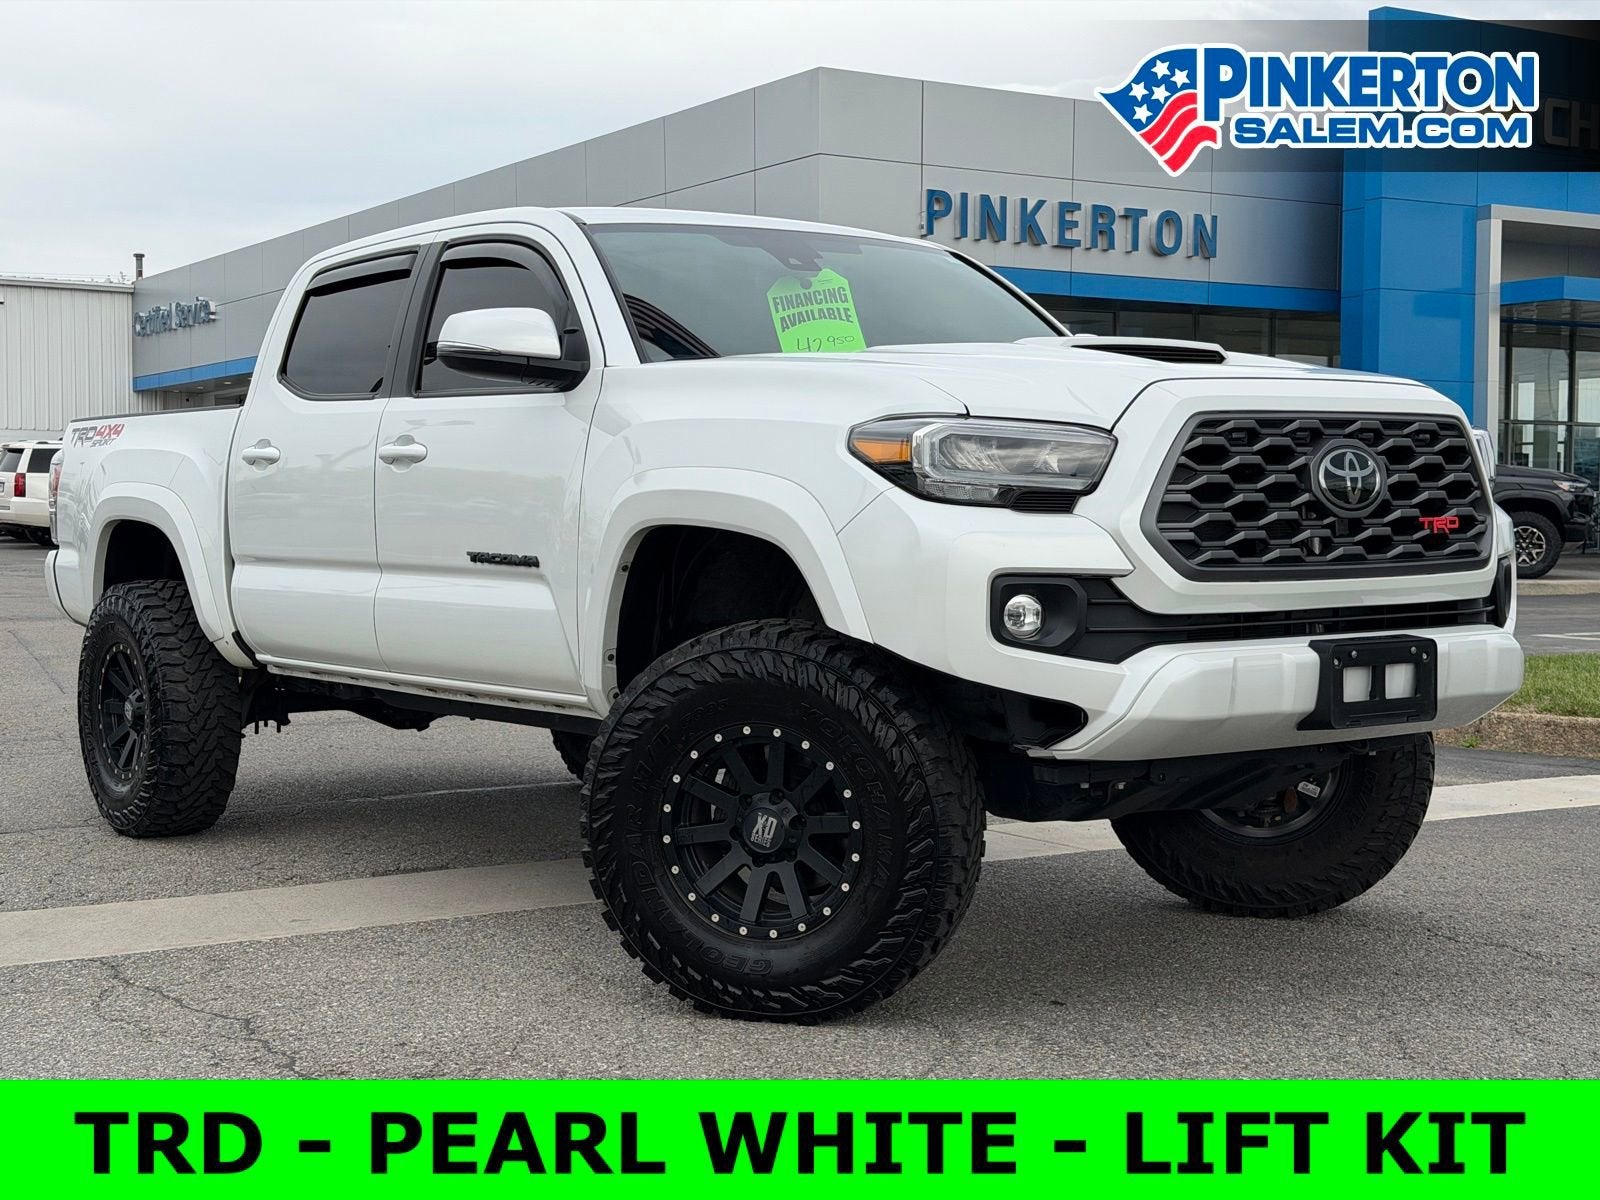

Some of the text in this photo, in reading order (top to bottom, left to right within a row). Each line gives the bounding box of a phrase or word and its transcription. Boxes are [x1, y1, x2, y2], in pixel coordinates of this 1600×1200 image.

[922, 188, 1218, 258] PINKERTON
[772, 286, 849, 313] FINANCING
[134, 296, 212, 337] Certified Service
[780, 306, 854, 333] AVAILABLE
[1418, 516, 1459, 534] TRD
[466, 551, 540, 568] TACOMA
[799, 702, 895, 889] YOKOHAMA
